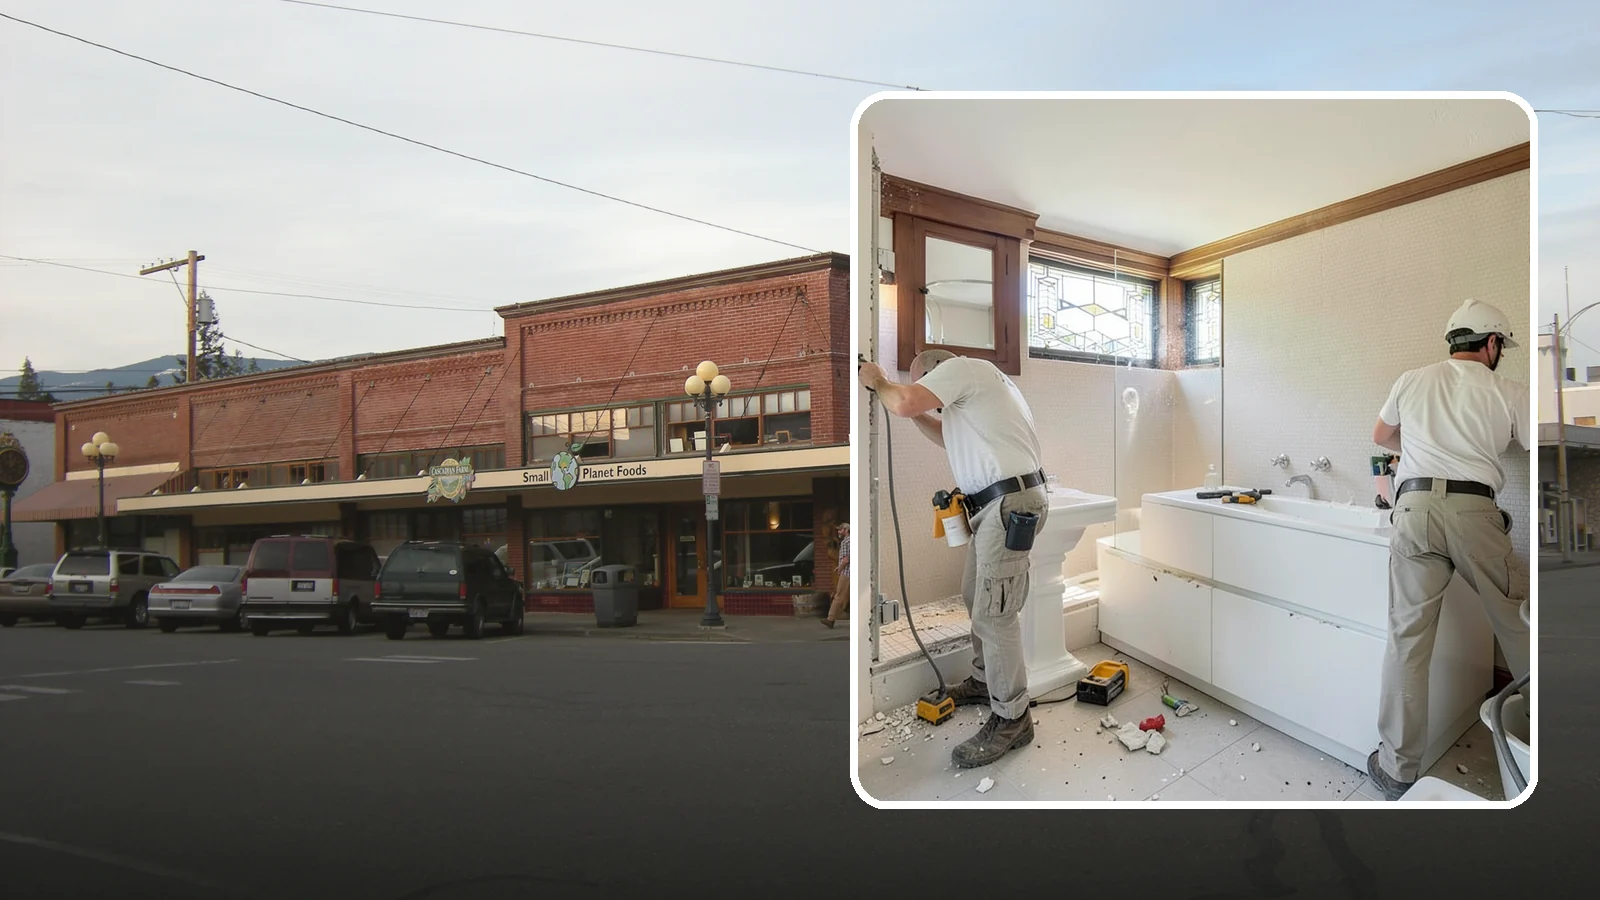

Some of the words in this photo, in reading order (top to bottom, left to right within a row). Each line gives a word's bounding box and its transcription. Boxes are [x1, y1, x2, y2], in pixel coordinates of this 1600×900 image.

[523, 471, 549, 483] Small
[583, 467, 614, 479] Planet
[617, 464, 647, 476] Foods
